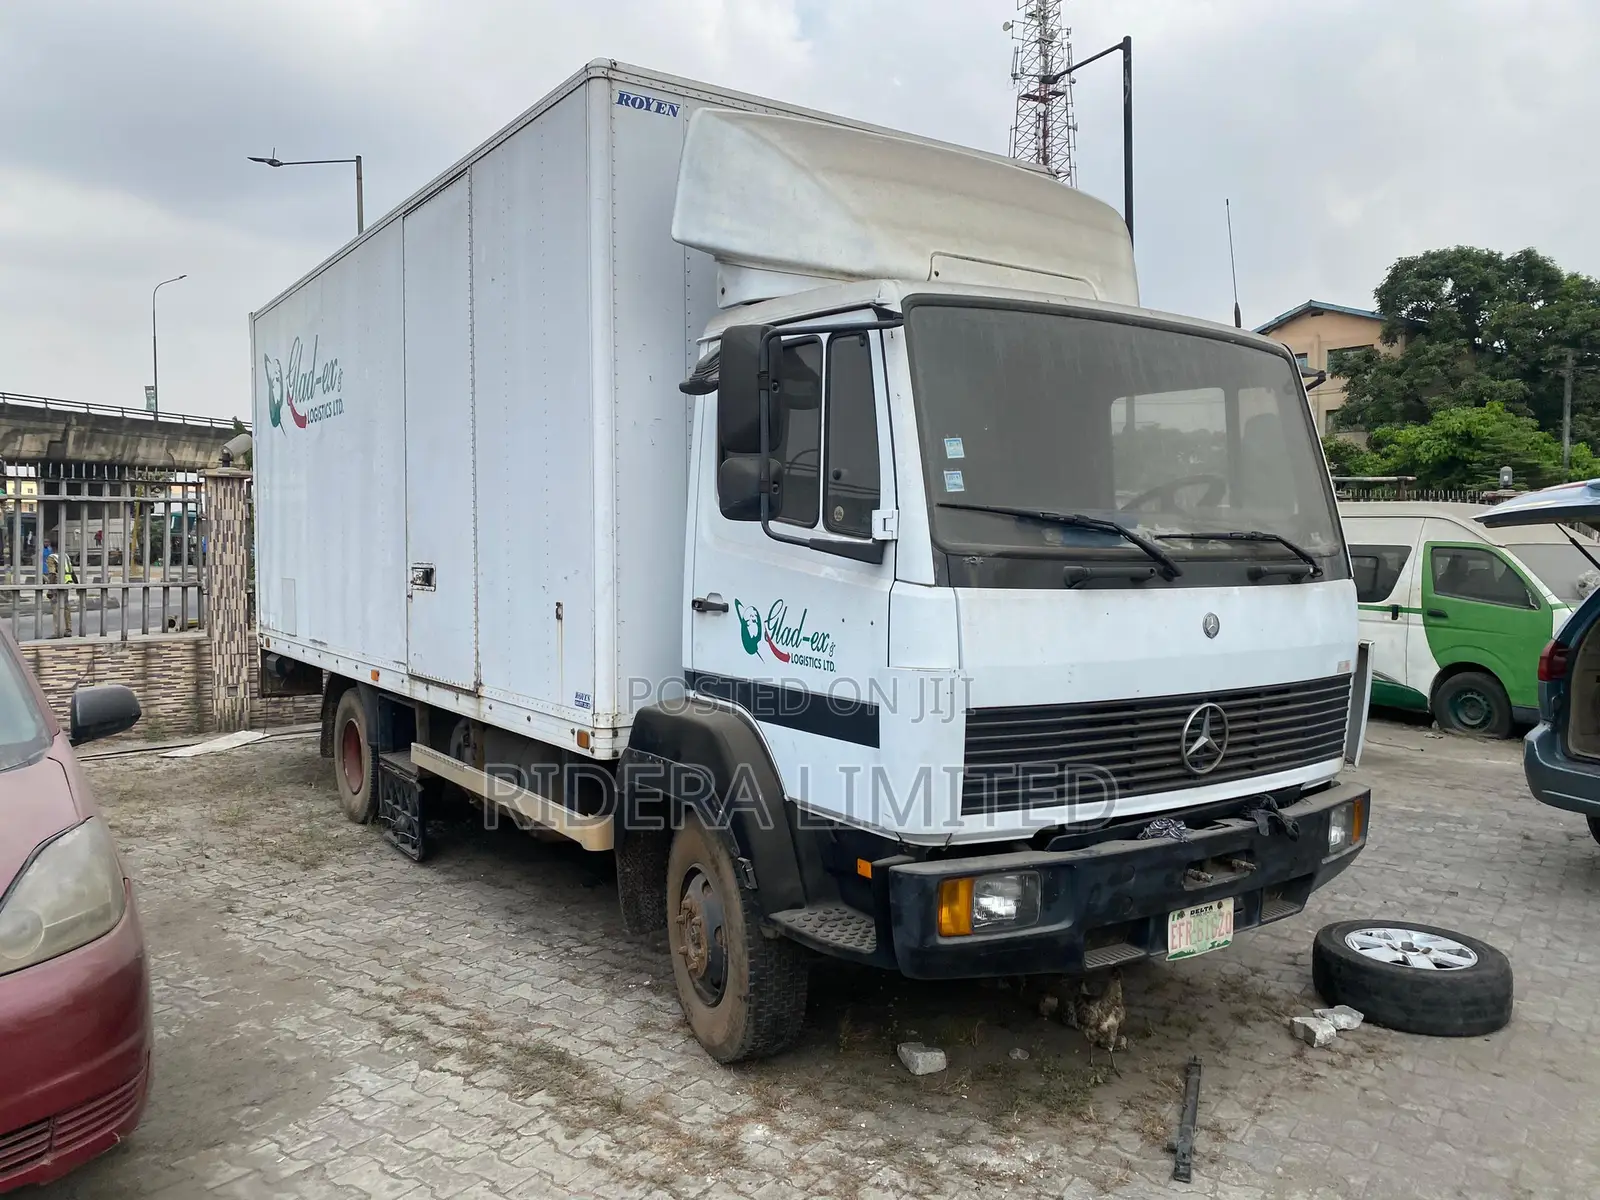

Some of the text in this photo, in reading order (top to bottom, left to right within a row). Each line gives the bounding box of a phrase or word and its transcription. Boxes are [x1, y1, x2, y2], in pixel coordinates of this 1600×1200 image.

[616, 91, 681, 118] ROYEN
[307, 398, 344, 425] LOGISTICS LTD.
[791, 653, 836, 672] LOGISTICS LTD.
[1190, 905, 1213, 916] DELTA
